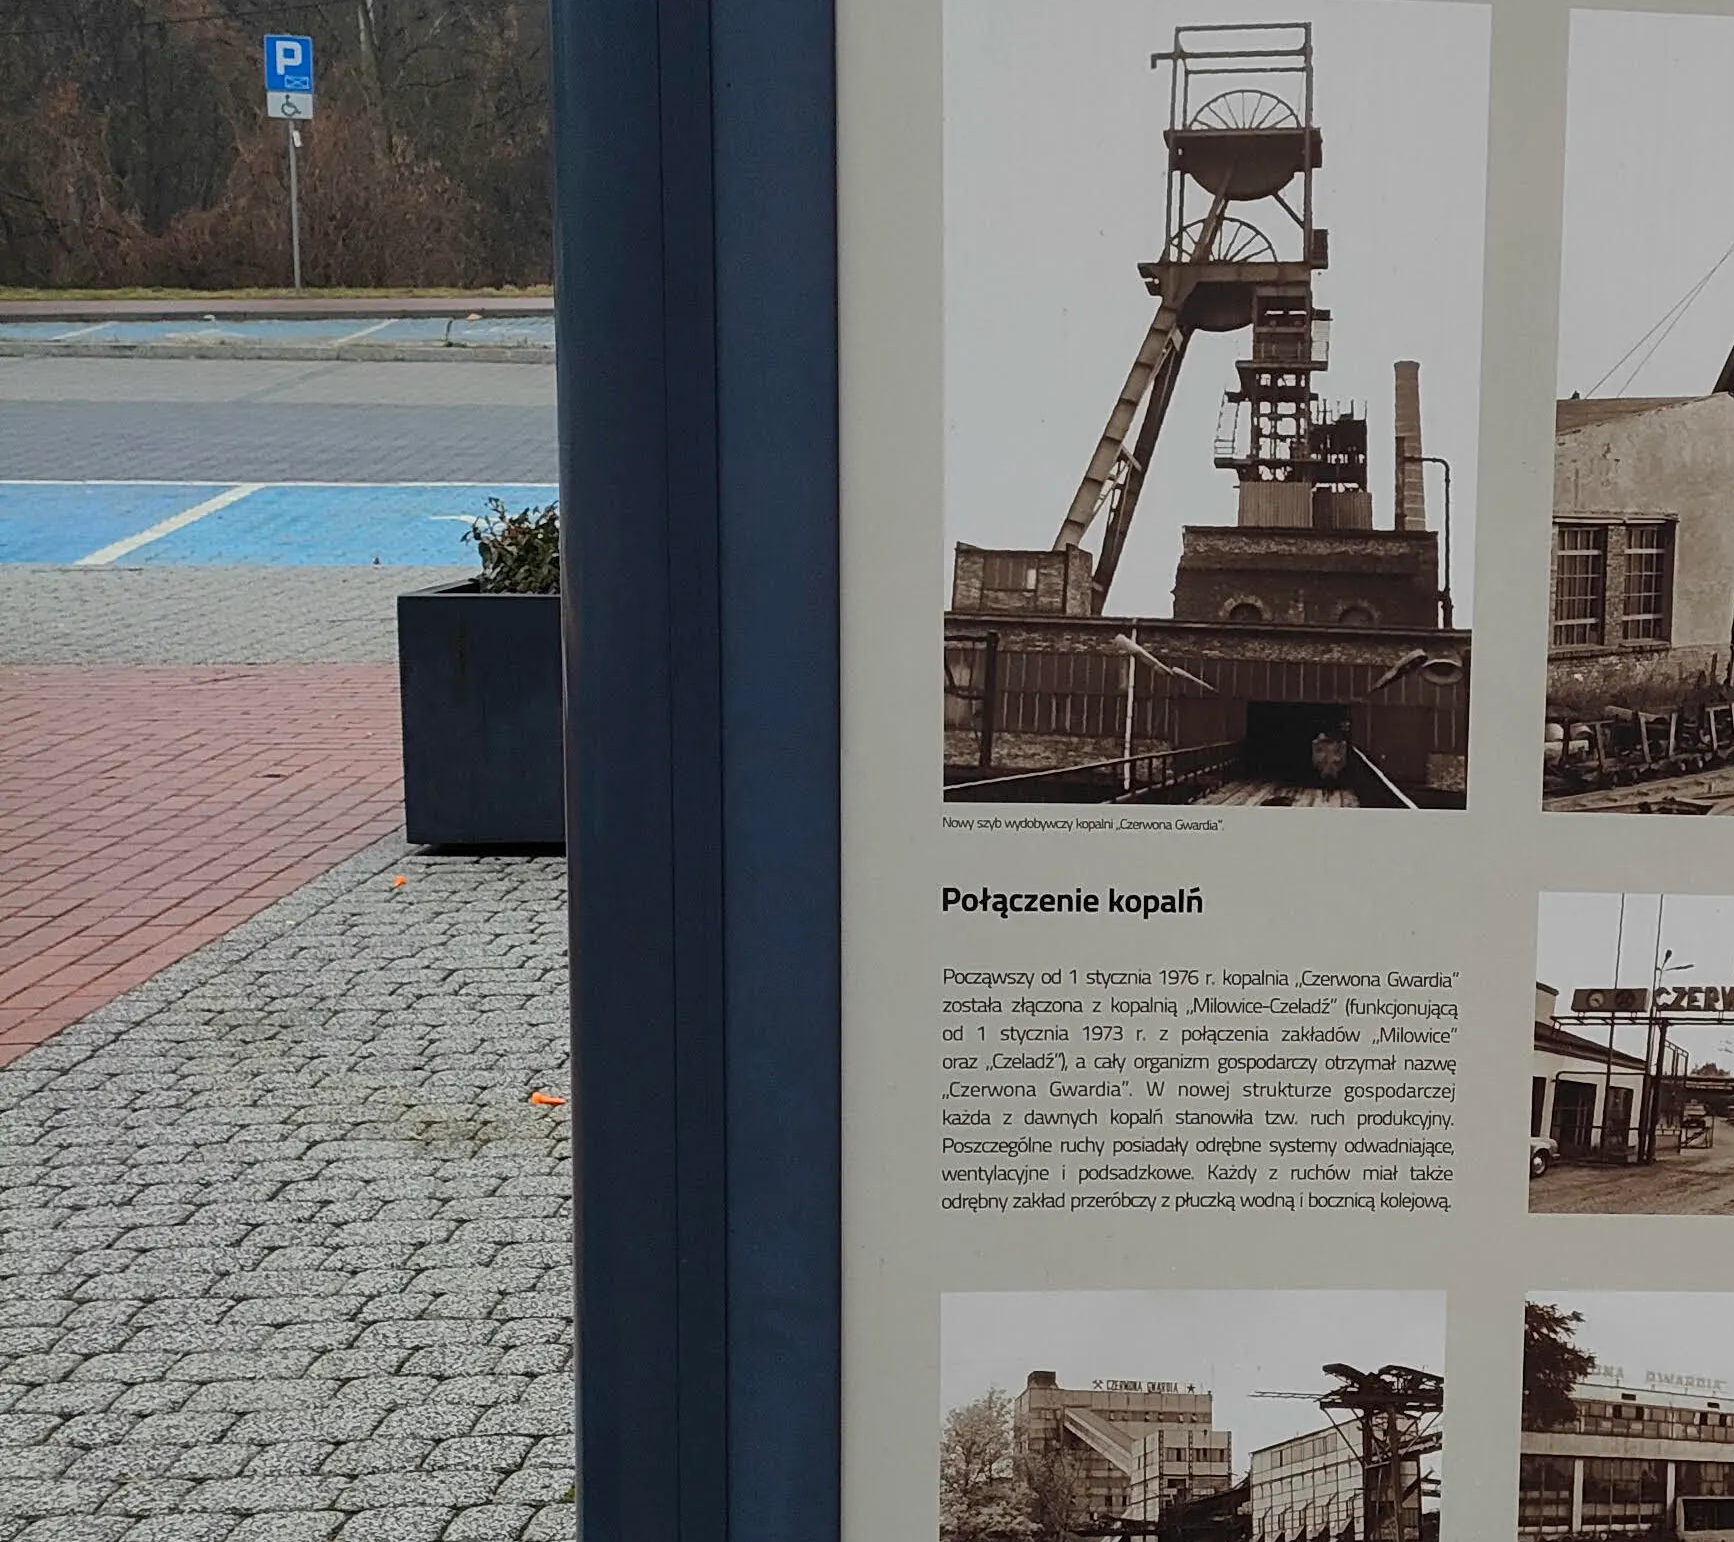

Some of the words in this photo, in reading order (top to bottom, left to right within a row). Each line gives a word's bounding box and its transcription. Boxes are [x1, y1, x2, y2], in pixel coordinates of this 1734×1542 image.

[276, 40, 302, 75] P
[943, 817, 974, 831] Nowy
[977, 817, 1002, 831] szyb
[1005, 818, 1073, 832] wydobywczy
[1076, 819, 1113, 832] kopalni
[943, 887, 1099, 919] Połączenie
[1110, 887, 1202, 919] kopalń
[944, 969, 1035, 989] Począwszy
[1042, 969, 1061, 984] od
[1069, 970, 1077, 984] 1
[1087, 970, 1152, 989] stycznia
[1160, 970, 1199, 985] 1976
[1206, 974, 1215, 985] r.
[1223, 969, 1289, 990] kopalnia
[943, 997, 1002, 1013] została
[1012, 997, 1083, 1017] złączona
[1093, 1001, 1101, 1012] z
[1112, 997, 1178, 1017] kopalnią
[1346, 998, 1458, 1020] (funkcjonującą
[943, 1025, 963, 1041] od
[977, 1027, 985, 1041] 1
[1001, 1025, 1069, 1045] stycznia
[1083, 1026, 1123, 1041] 1973
[1137, 1030, 1145, 1041] r.
[1160, 1030, 1168, 1041] z
[1182, 1025, 1269, 1045] połączenia
[1282, 1026, 1360, 1042] zakładów
[943, 1058, 978, 1069] oraz
[1076, 1057, 1086, 1069] a
[1094, 1053, 1126, 1073] cały
[1134, 1054, 1209, 1074] organizm
[1218, 1054, 1318, 1074] gospodarczy
[1326, 1055, 1396, 1074] otrzymał
[1405, 1059, 1456, 1075] nazwę
[1146, 1081, 1165, 1096] W
[1179, 1082, 1229, 1101] nowej
[1243, 1081, 1331, 1097] strukturze
[1344, 1083, 1455, 1103] gospodarczej
[943, 1109, 991, 1125] każda
[1004, 1114, 1012, 1125] z
[1024, 1109, 1097, 1129] dawnych
[1111, 1109, 1163, 1129] kopalń
[1176, 1109, 1253, 1125] stanowiła
[1265, 1111, 1297, 1125] tzw.
[1311, 1109, 1344, 1125] ruch
[1358, 1110, 1454, 1130] produkcyjny.
[943, 1137, 1052, 1157] Poszczególne
[1061, 1137, 1105, 1157] ruchy
[1114, 1137, 1189, 1156] posiadały
[1196, 1137, 1261, 1156] odrębne
[1270, 1138, 1337, 1157] systemy
[1345, 1138, 1454, 1157] odwadniające,
[942, 1165, 1049, 1185] wentylacyjne
[1062, 1165, 1066, 1180] i
[1079, 1165, 1194, 1185] podsadzkowe.
[1208, 1165, 1257, 1184] Każdy
[1270, 1169, 1278, 1180] z
[1291, 1164, 1350, 1180] ruchów
[1364, 1165, 1398, 1180] miał
[1410, 1165, 1453, 1181] także
[942, 1193, 1008, 1213] odrębny
[1013, 1193, 1065, 1208] zakład
[1071, 1192, 1157, 1212] przeróbczy
[1162, 1196, 1170, 1207] z
[1176, 1192, 1236, 1212] płuczką
[1240, 1192, 1295, 1211] wodną
[1299, 1193, 1304, 1207] i
[1309, 1192, 1375, 1212] bocznicą
[1381, 1193, 1451, 1212] kolejową.
